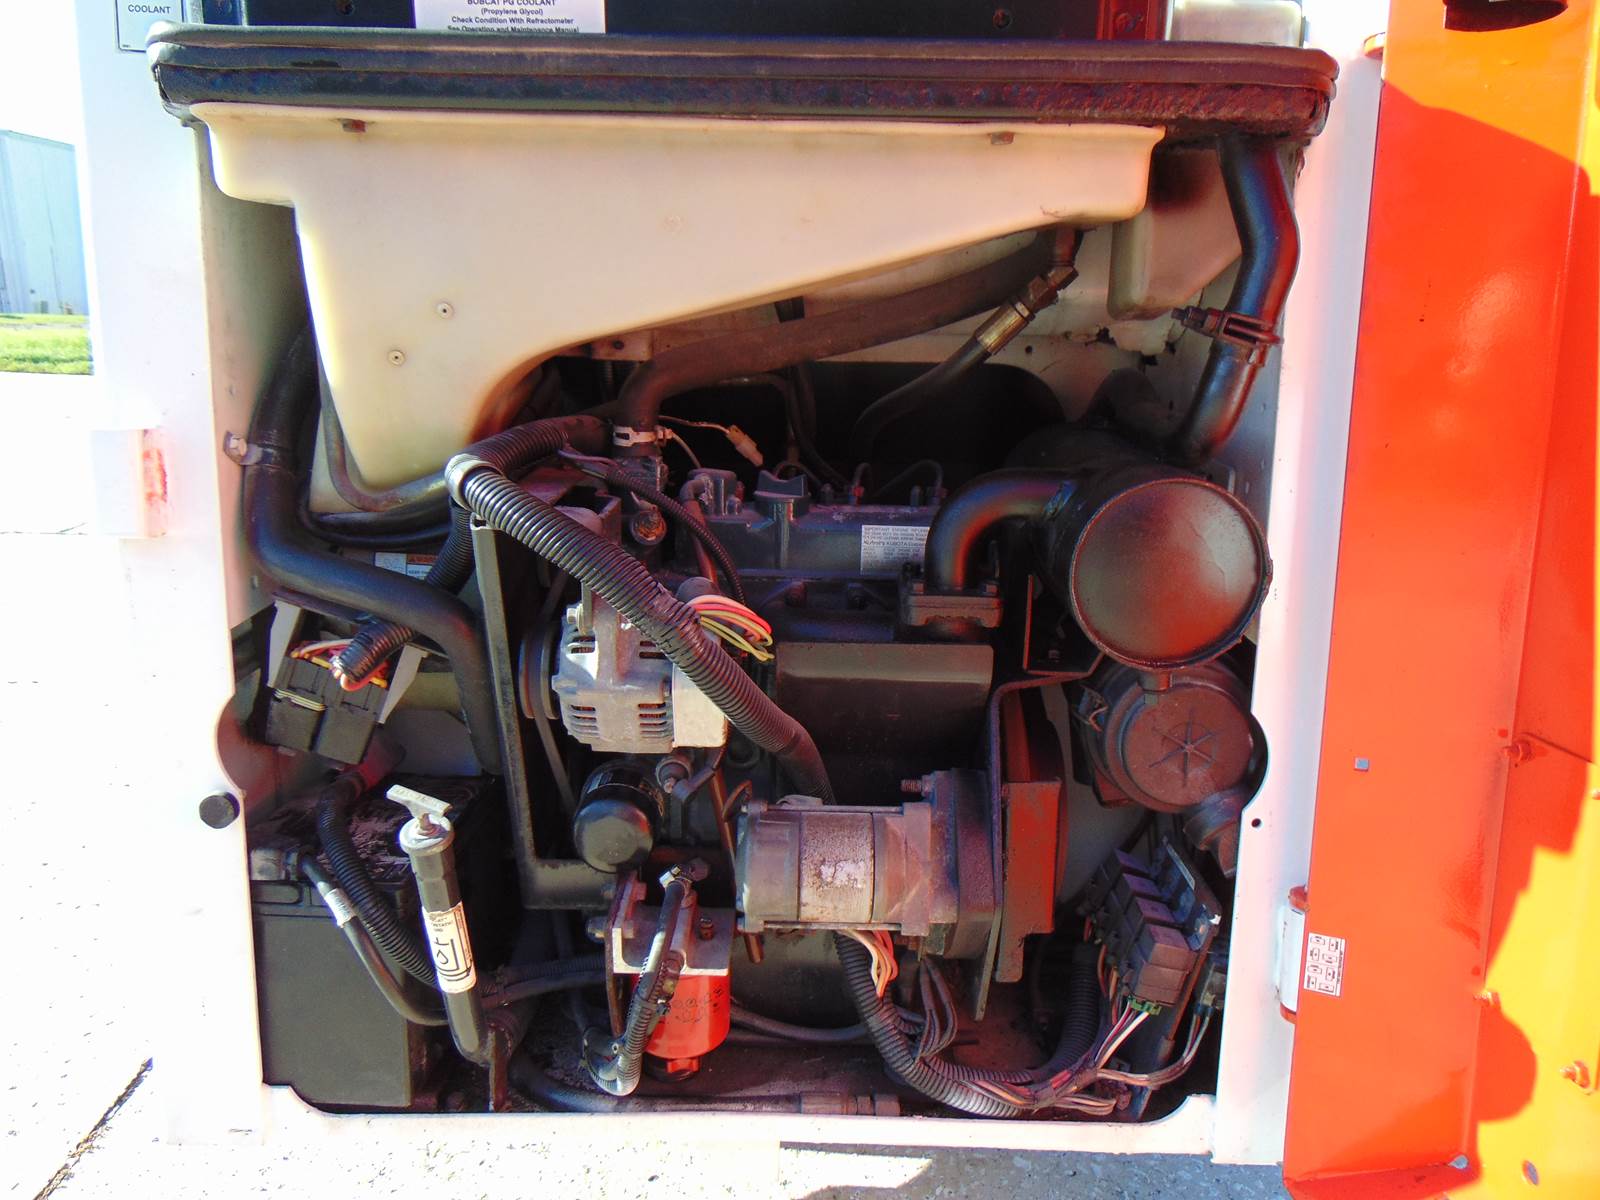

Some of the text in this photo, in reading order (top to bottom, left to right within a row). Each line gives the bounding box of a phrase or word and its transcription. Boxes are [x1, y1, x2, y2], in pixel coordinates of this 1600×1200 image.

[127, 4, 171, 14] COOLANT
[481, 7, 544, 16] (Propylene Glycol)
